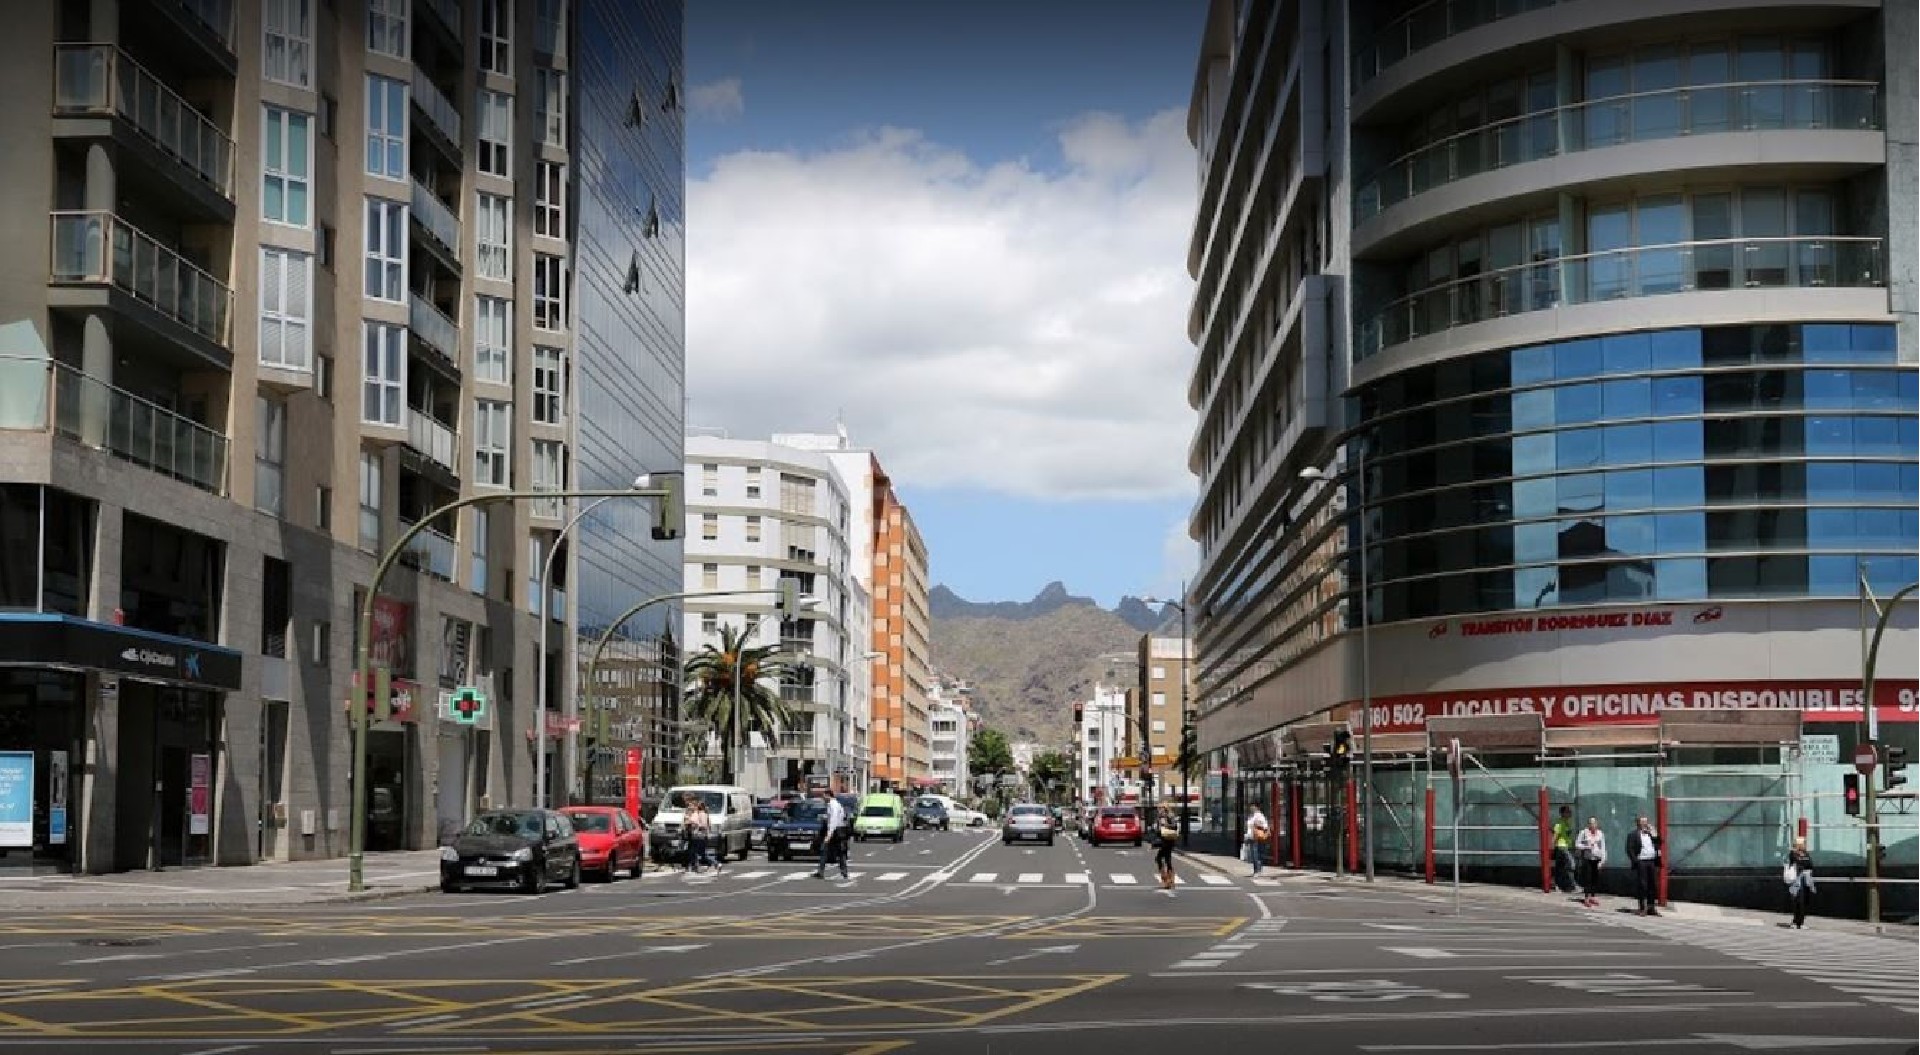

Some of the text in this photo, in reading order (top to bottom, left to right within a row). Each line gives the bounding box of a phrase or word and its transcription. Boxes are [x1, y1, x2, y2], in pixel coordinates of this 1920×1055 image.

[1393, 703, 1424, 726] 502
[1443, 697, 1535, 718] LOCALES
[1540, 696, 1557, 718] Y
[1563, 691, 1685, 718] OFICINAS
[1694, 688, 1866, 712] DISPONIBLES
